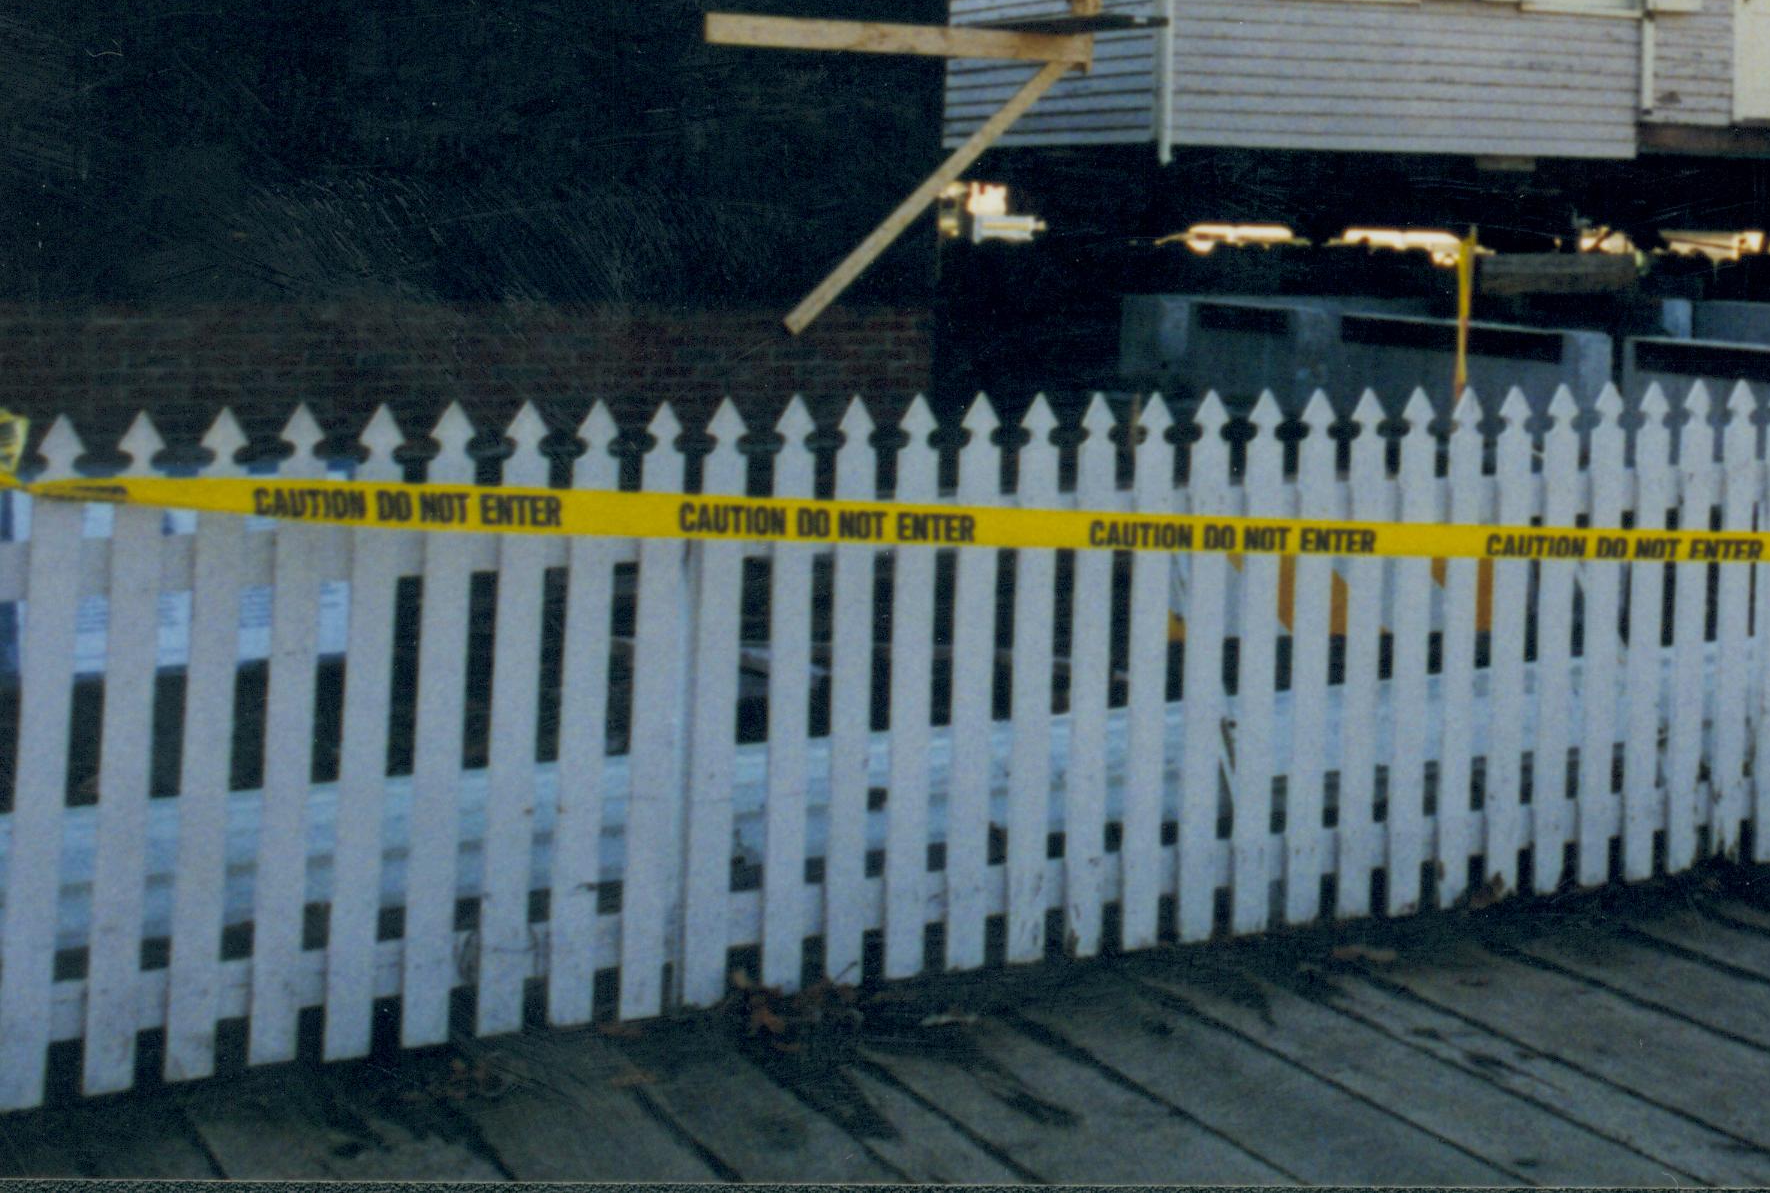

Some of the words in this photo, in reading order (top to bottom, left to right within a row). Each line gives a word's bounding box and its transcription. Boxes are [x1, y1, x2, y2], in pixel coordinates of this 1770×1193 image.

[253, 488, 366, 519] CAUTION
[375, 490, 411, 521] DO
[419, 492, 470, 523] NOT
[479, 494, 563, 526] ENTER
[679, 502, 786, 535] CAUTION
[797, 507, 830, 538] DO
[839, 510, 888, 539] NOT
[896, 513, 975, 542] ENTER
[1089, 520, 1193, 548] CAUTION
[1203, 524, 1235, 550] DO
[1244, 526, 1291, 551] NOT
[1300, 527, 1376, 553] ENTER
[1486, 534, 1587, 556] CAUTION
[1596, 537, 1627, 557] DO
[1635, 538, 1683, 558] NOT
[1689, 539, 1764, 560] ENTER
